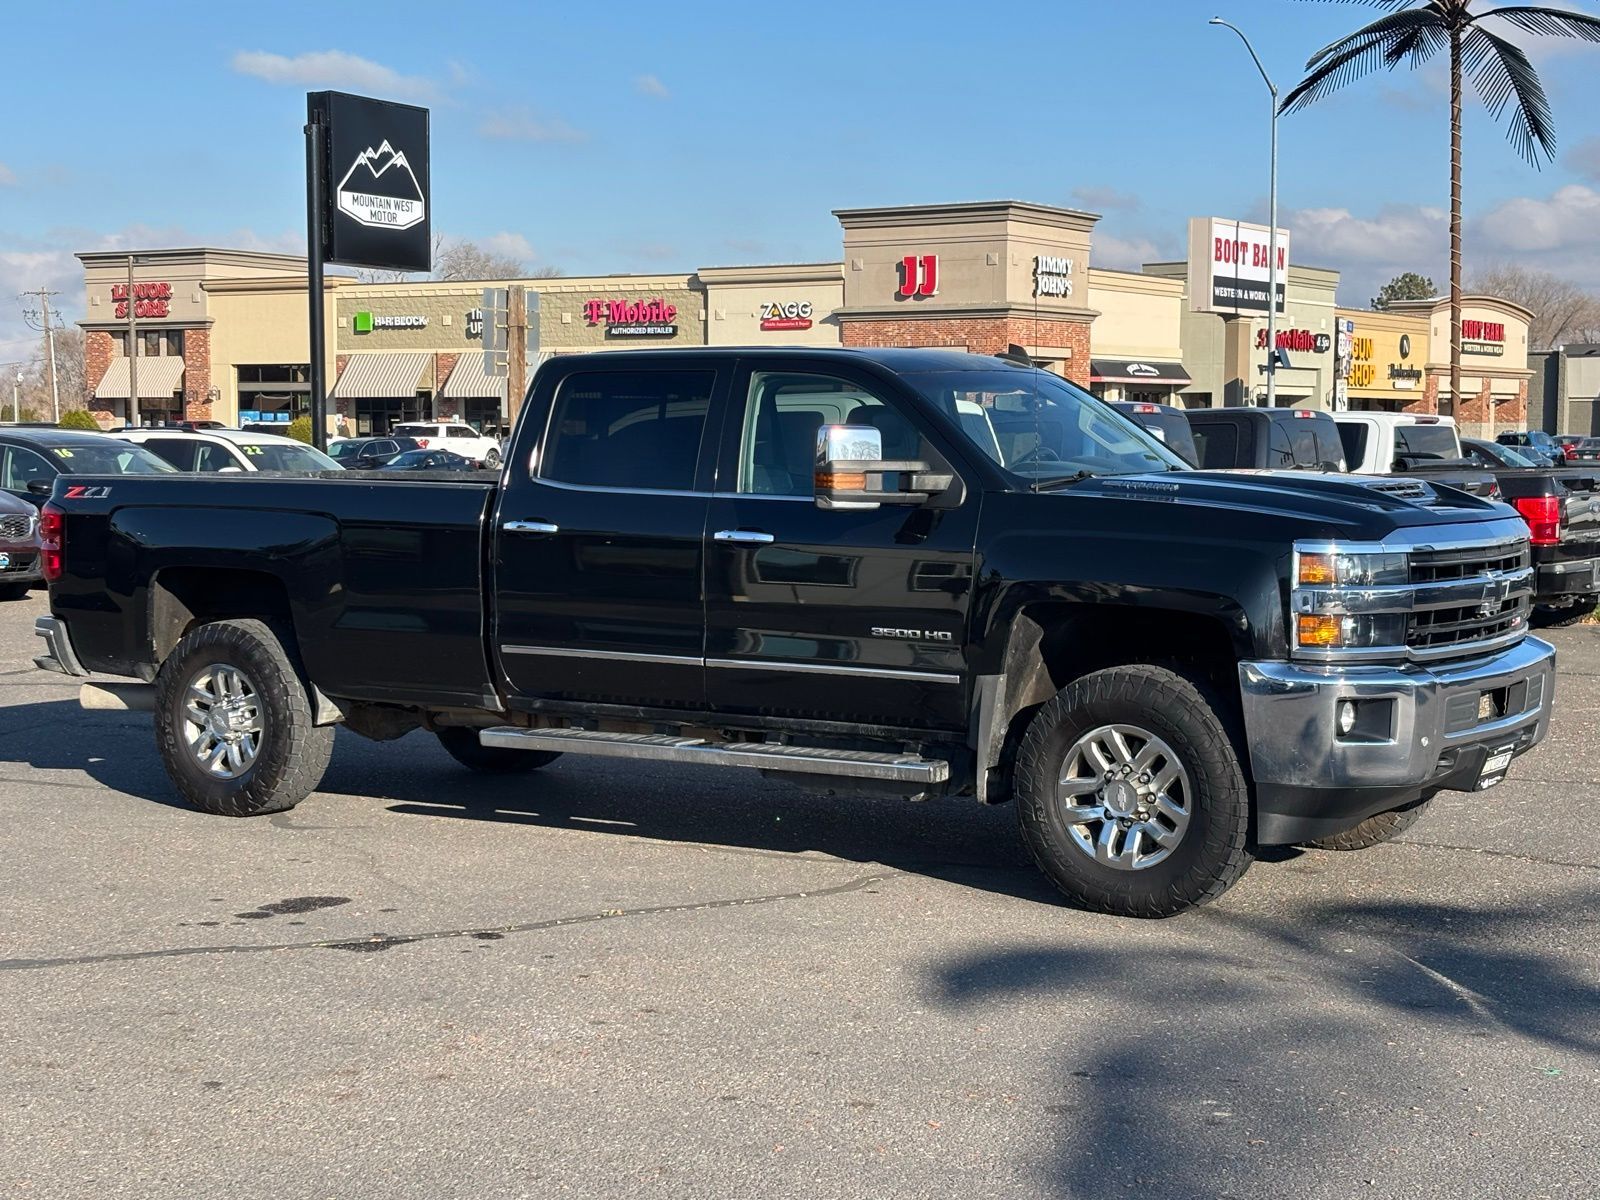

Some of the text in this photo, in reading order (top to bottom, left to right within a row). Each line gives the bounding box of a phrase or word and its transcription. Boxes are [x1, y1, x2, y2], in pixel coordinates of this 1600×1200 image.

[352, 194, 413, 213] MOUNTAIN WEST
[370, 210, 398, 223] MOTOR
[1215, 237, 1285, 270] BOOT BAN
[1037, 256, 1073, 274] JIMMY
[901, 255, 939, 296] JJ
[1036, 276, 1073, 295] JOHN'S
[1244, 290, 1249, 300] &
[1249, 290, 1267, 301] WORK
[1267, 292, 1283, 303] AR
[470, 308, 482, 320] Th
[761, 301, 813, 319] ZAGG
[394, 315, 429, 326] BLOCK
[470, 322, 483, 334] UP
[611, 326, 673, 335] AUTHORIZED RETAILER
[1462, 320, 1505, 342] BOOT BARN
[1352, 337, 1374, 359] GUN
[1348, 364, 1376, 386] SHOP
[54, 448, 74, 458] 16
[243, 446, 264, 455] 22
[64, 486, 112, 499] Z71
[871, 627, 952, 640] 3500 HD
